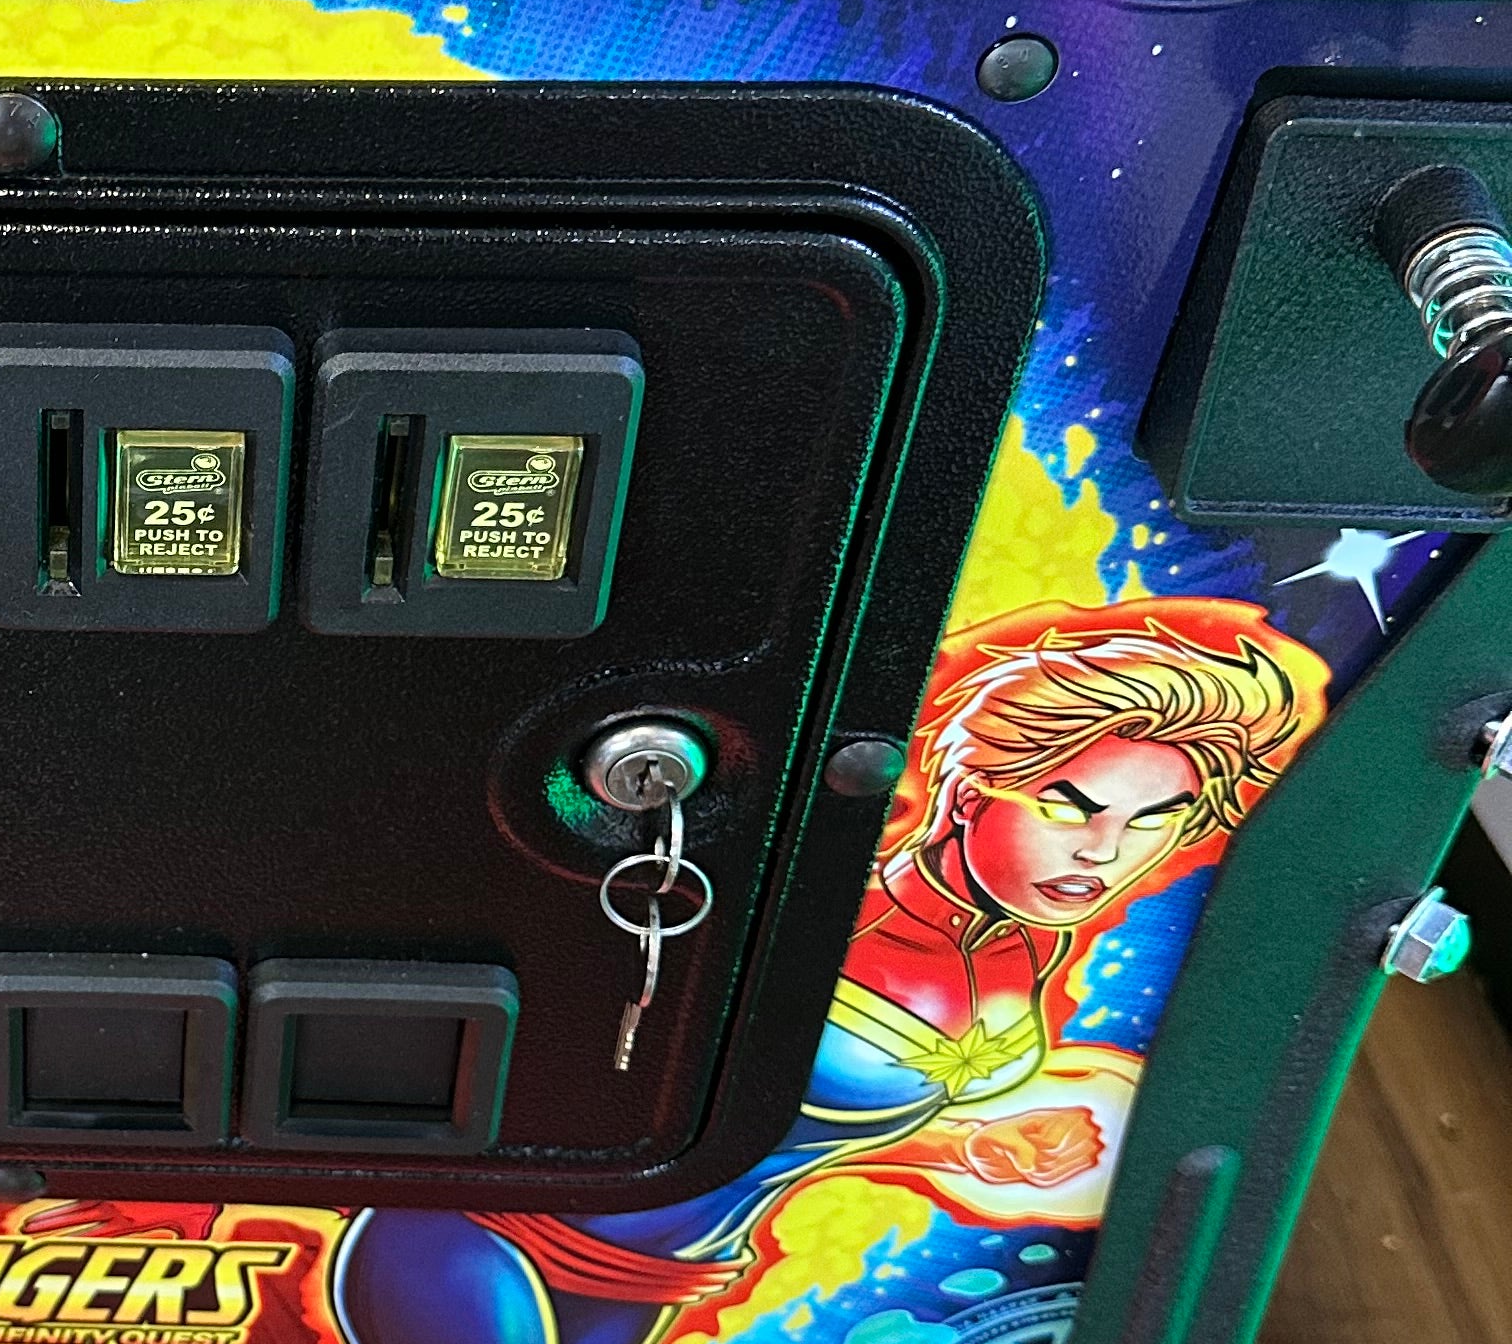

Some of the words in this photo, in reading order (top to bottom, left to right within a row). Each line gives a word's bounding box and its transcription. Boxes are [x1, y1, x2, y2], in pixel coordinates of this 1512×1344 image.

[145, 473, 221, 486] Stern
[477, 474, 553, 487] Stern
[143, 500, 216, 526] 25¢
[470, 501, 545, 528] 25¢
[134, 529, 190, 542] PUSH
[195, 529, 224, 542] TO
[459, 530, 517, 544] PUSH
[522, 531, 551, 545] TO
[139, 543, 219, 556] REJECT
[463, 546, 544, 559] REJECT
